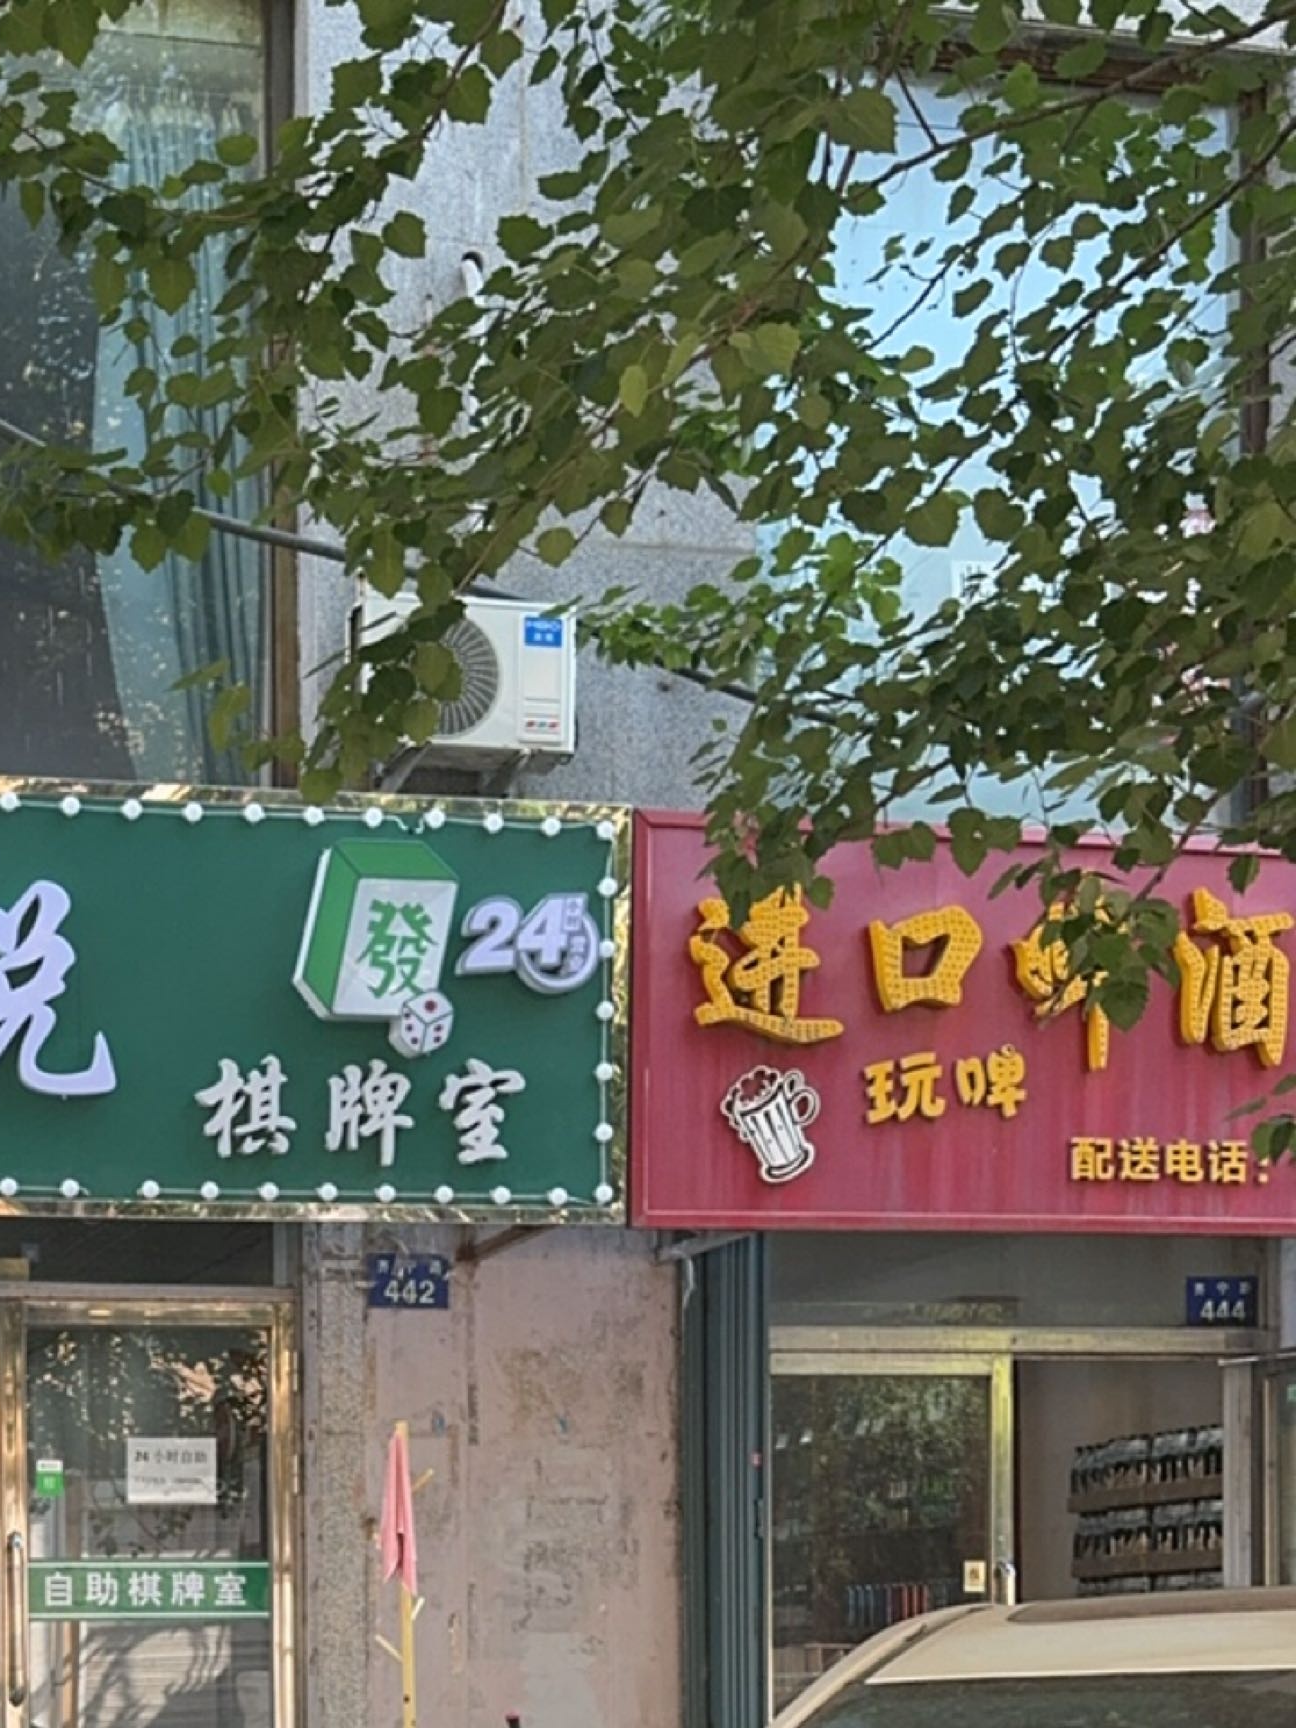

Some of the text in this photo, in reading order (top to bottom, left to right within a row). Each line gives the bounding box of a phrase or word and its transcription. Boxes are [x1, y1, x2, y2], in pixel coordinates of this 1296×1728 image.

[864, 1046, 1027, 1124] 玩啤
[194, 1054, 526, 1167] 棋牌室
[384, 1279, 436, 1304] 442
[1200, 1299, 1246, 1320] 444
[44, 1571, 247, 1607] 自助棋牌室
